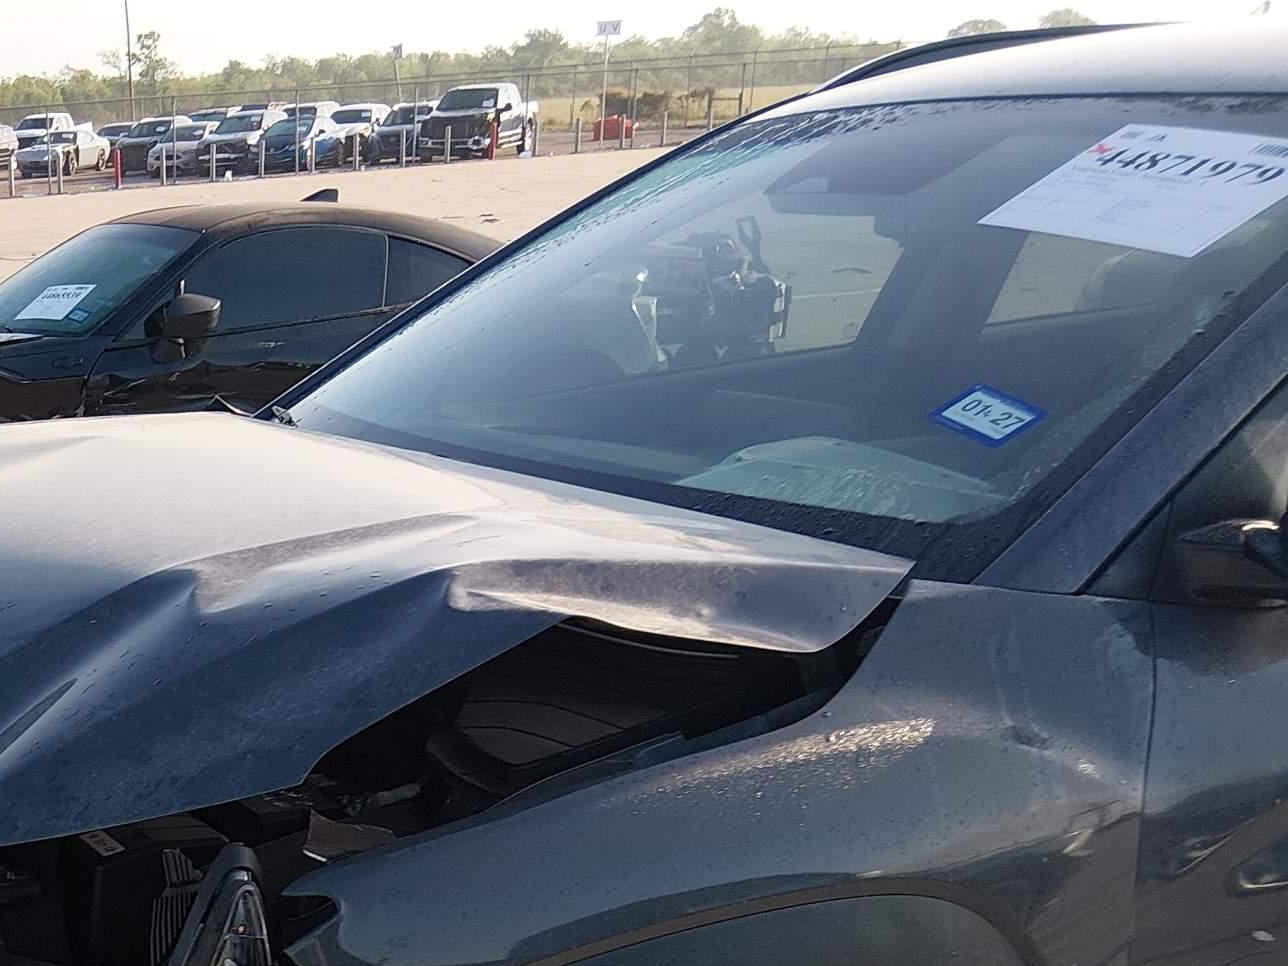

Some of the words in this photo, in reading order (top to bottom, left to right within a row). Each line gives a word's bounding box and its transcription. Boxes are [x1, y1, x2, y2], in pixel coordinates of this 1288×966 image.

[1095, 149, 1286, 186] 44871979
[961, 399, 993, 417] 01
[990, 411, 1036, 429] 27
